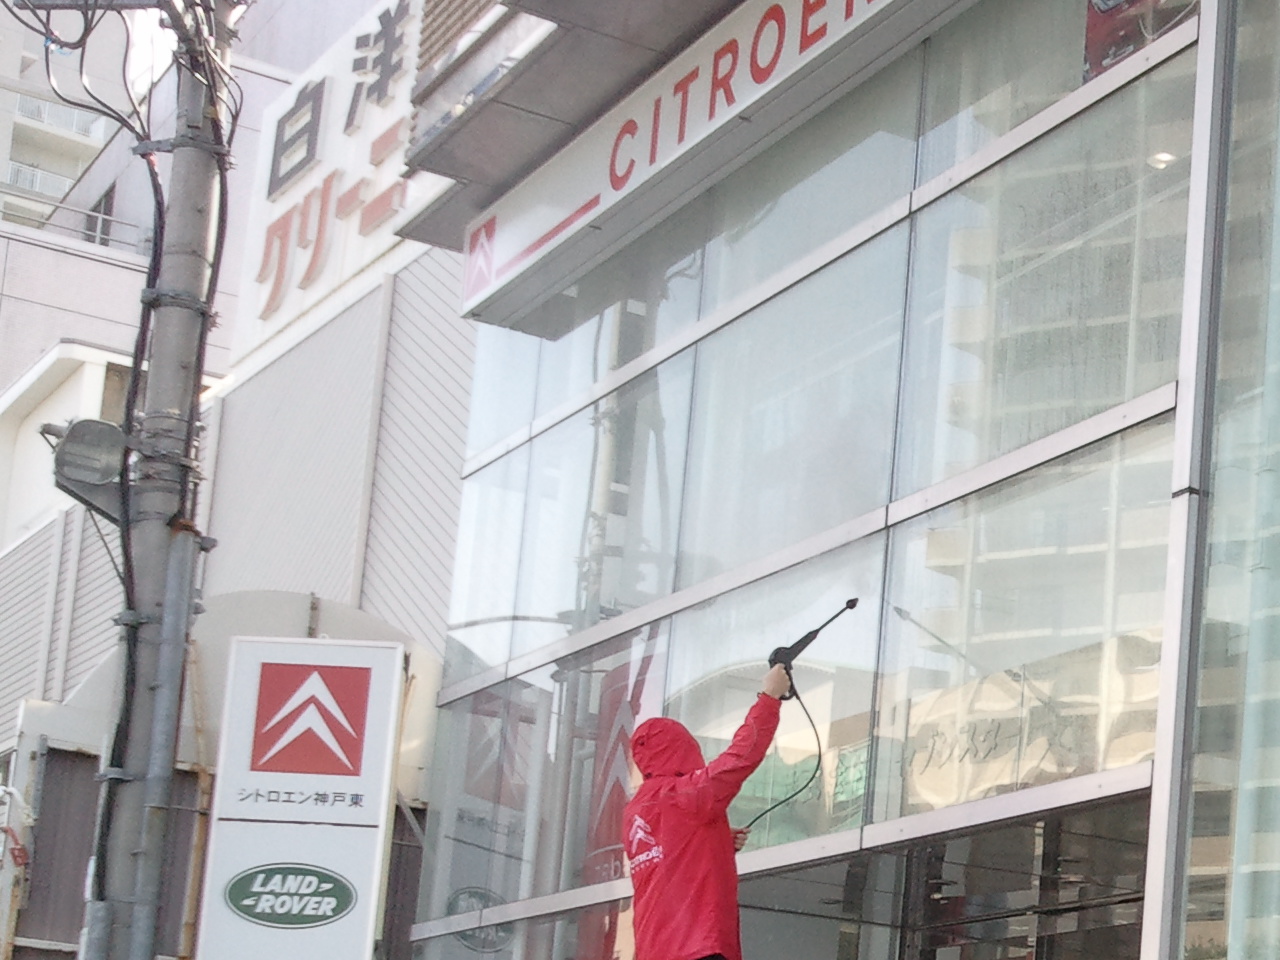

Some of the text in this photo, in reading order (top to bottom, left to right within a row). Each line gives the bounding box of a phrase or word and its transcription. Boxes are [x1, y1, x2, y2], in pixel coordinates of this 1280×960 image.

[609, 0, 874, 191] CITROE
[238, 788, 365, 808] シトロエン神戸東
[251, 873, 320, 895] LAND
[255, 894, 338, 916] ROVER
